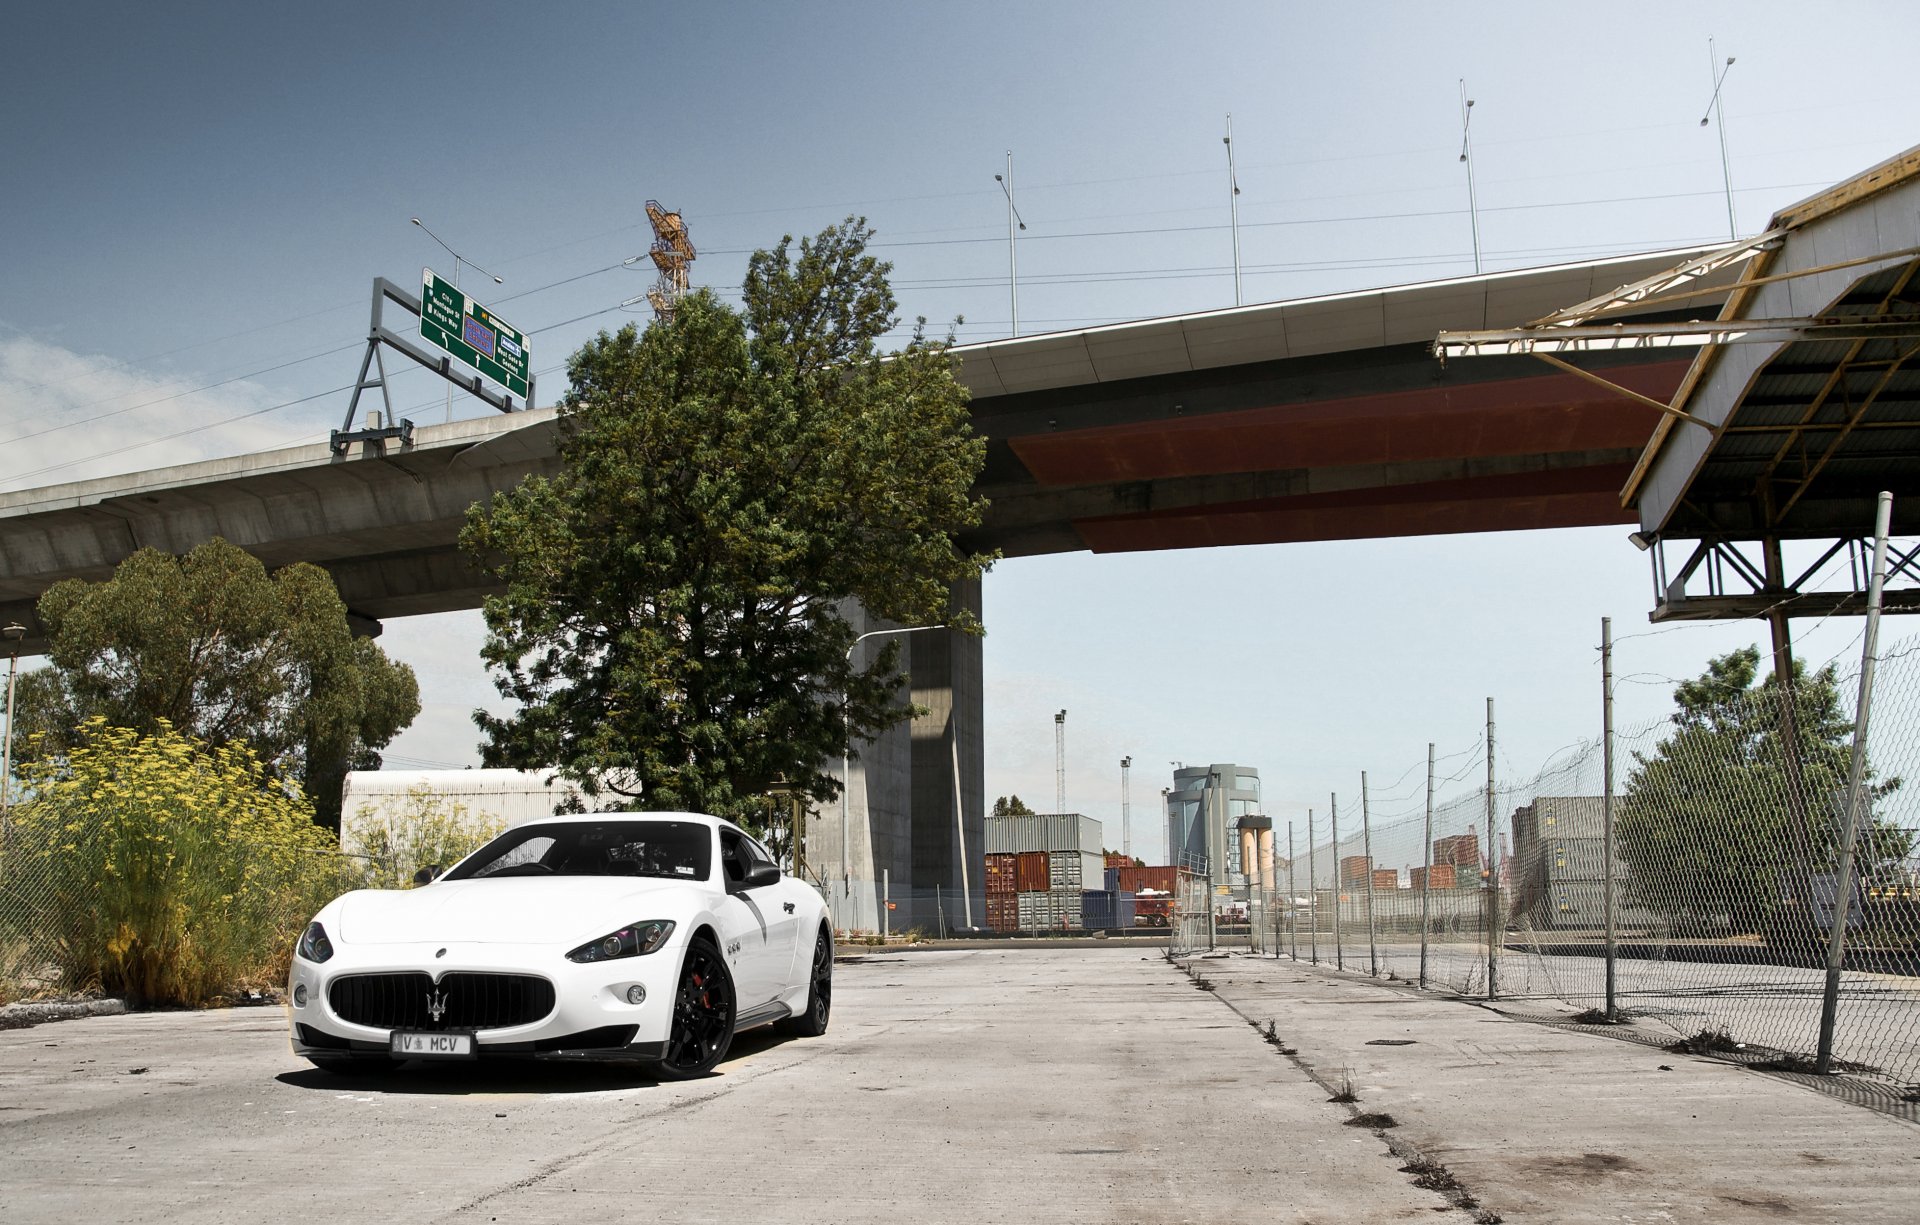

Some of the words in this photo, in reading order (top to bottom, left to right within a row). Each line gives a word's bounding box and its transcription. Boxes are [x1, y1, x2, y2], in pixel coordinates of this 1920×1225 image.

[433, 296, 454, 315] Montague
[455, 311, 460, 319] St
[442, 292, 453, 306] City
[433, 308, 447, 322] Kings
[448, 317, 458, 330] Way
[497, 347, 508, 358] West
[508, 352, 518, 365] Gate
[502, 358, 519, 375] Geelong
[404, 1036, 412, 1050] V
[430, 1037, 457, 1051] MCV
